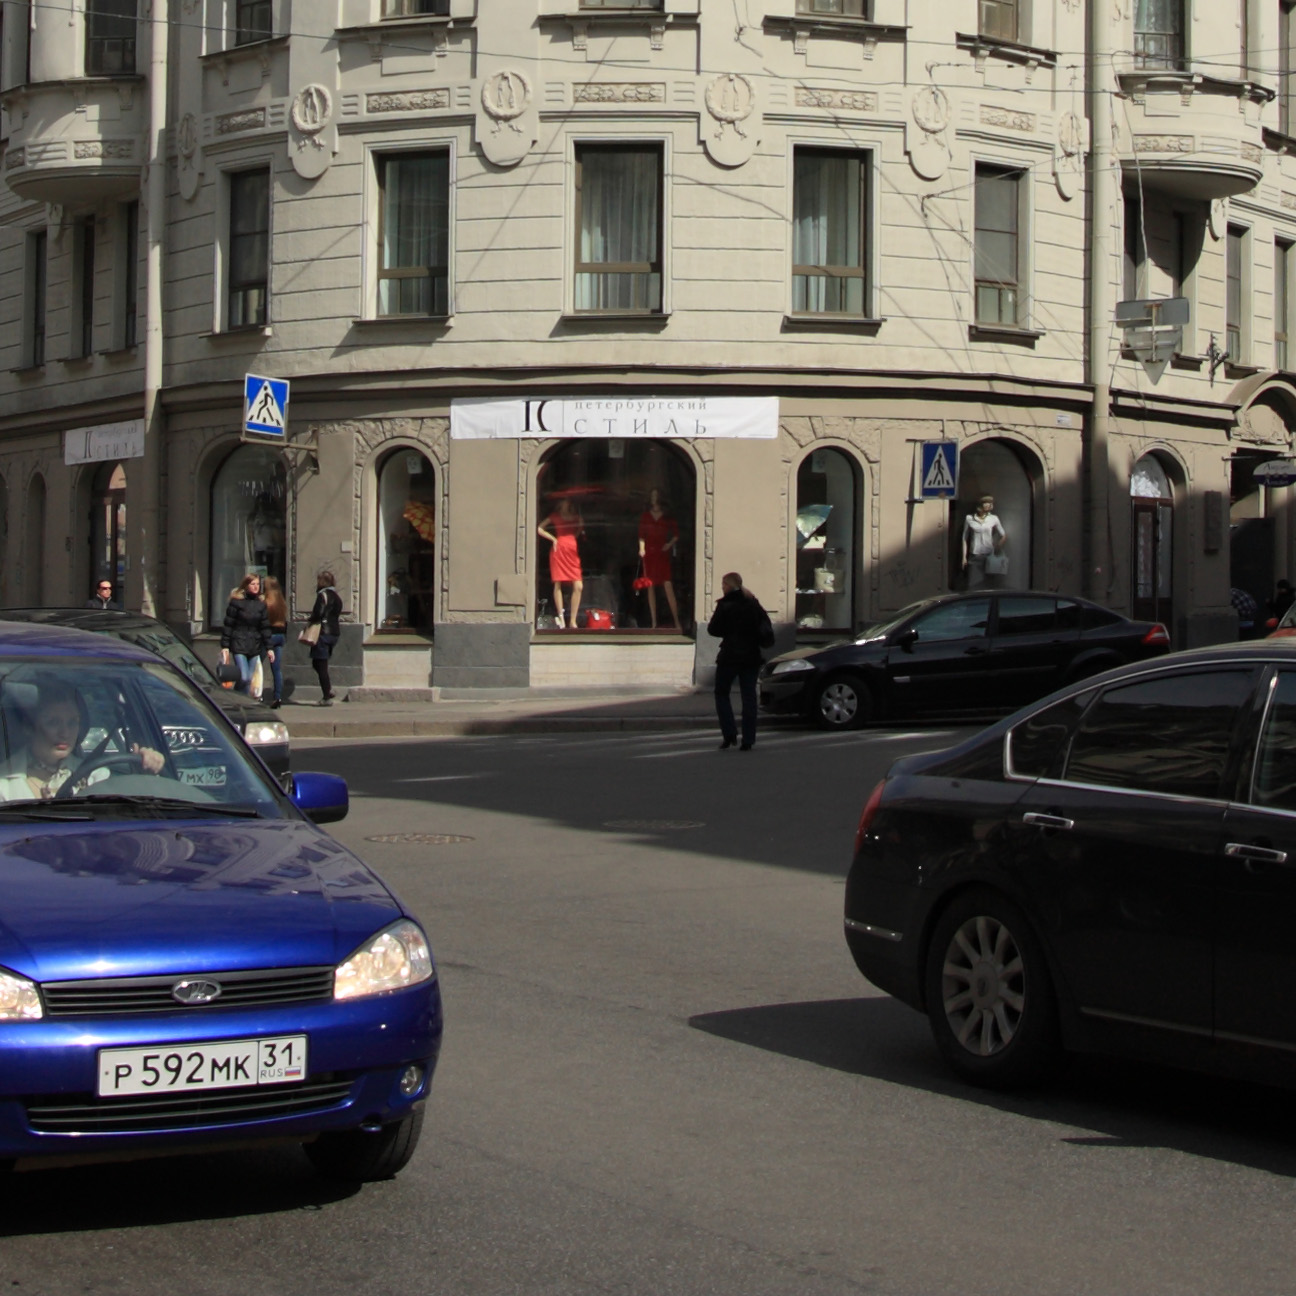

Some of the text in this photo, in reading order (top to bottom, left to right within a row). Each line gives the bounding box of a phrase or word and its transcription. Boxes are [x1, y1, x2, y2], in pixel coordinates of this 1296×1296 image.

[575, 398, 707, 413] петербургский
[574, 418, 707, 434] СТИЛЬ
[263, 1041, 293, 1068] 31
[260, 1067, 284, 1079] RUS
